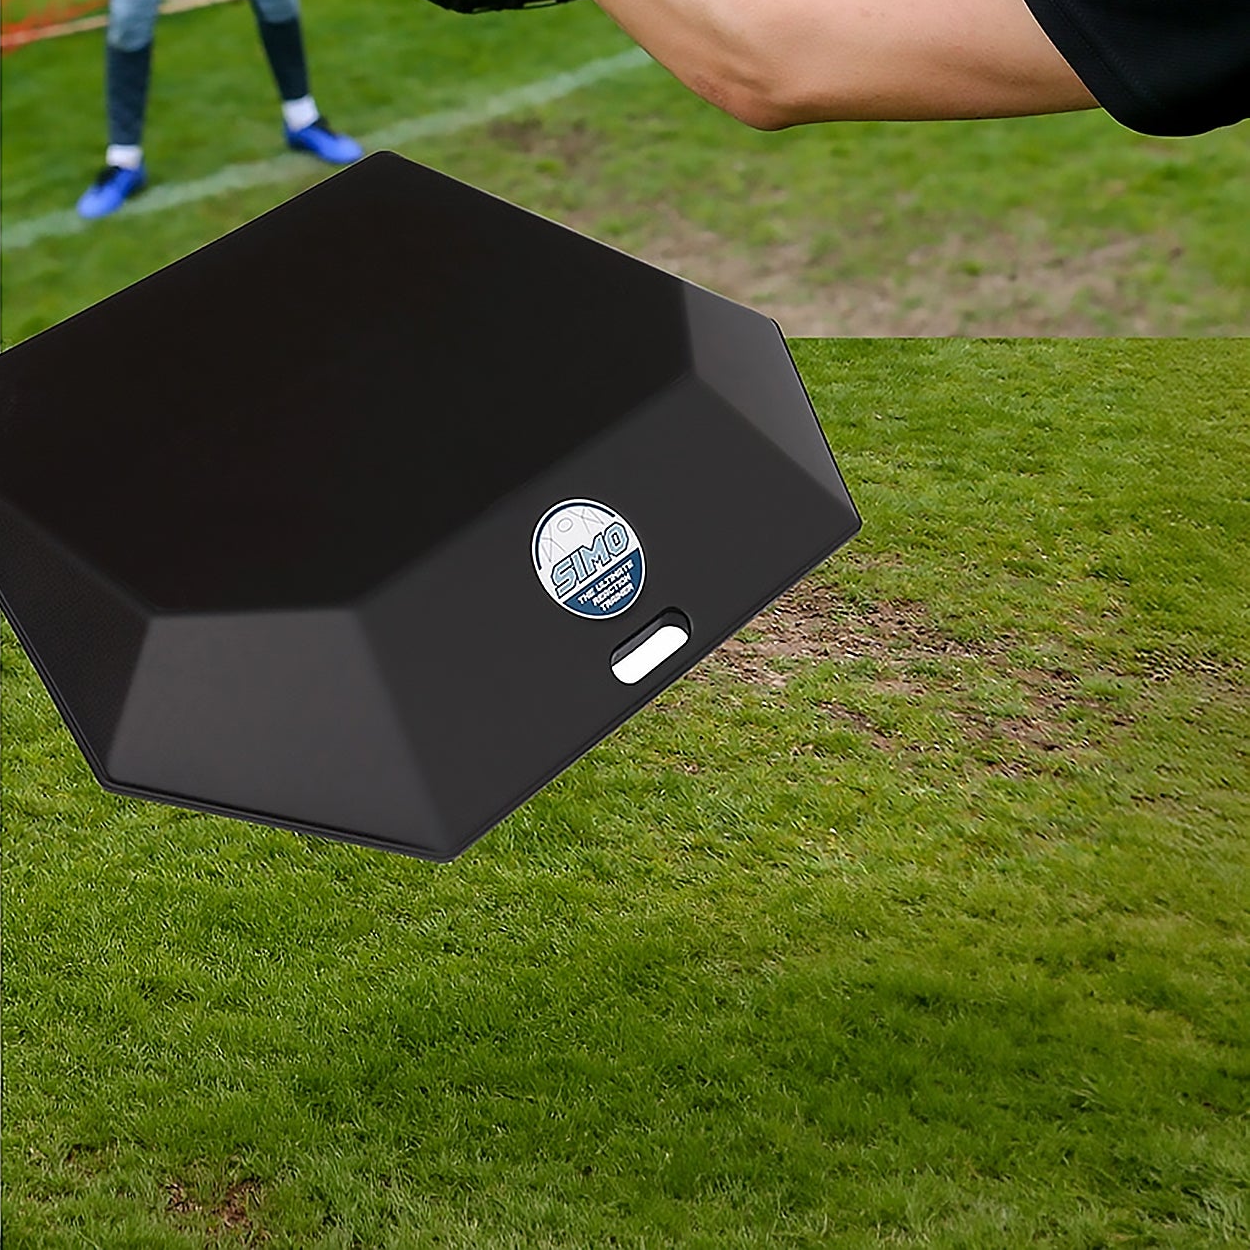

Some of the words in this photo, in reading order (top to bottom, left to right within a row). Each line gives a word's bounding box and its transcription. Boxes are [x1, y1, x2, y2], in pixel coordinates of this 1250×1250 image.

[551, 521, 630, 599] SIMO
[577, 587, 596, 605] THE
[595, 559, 635, 591] ULTIMATE
